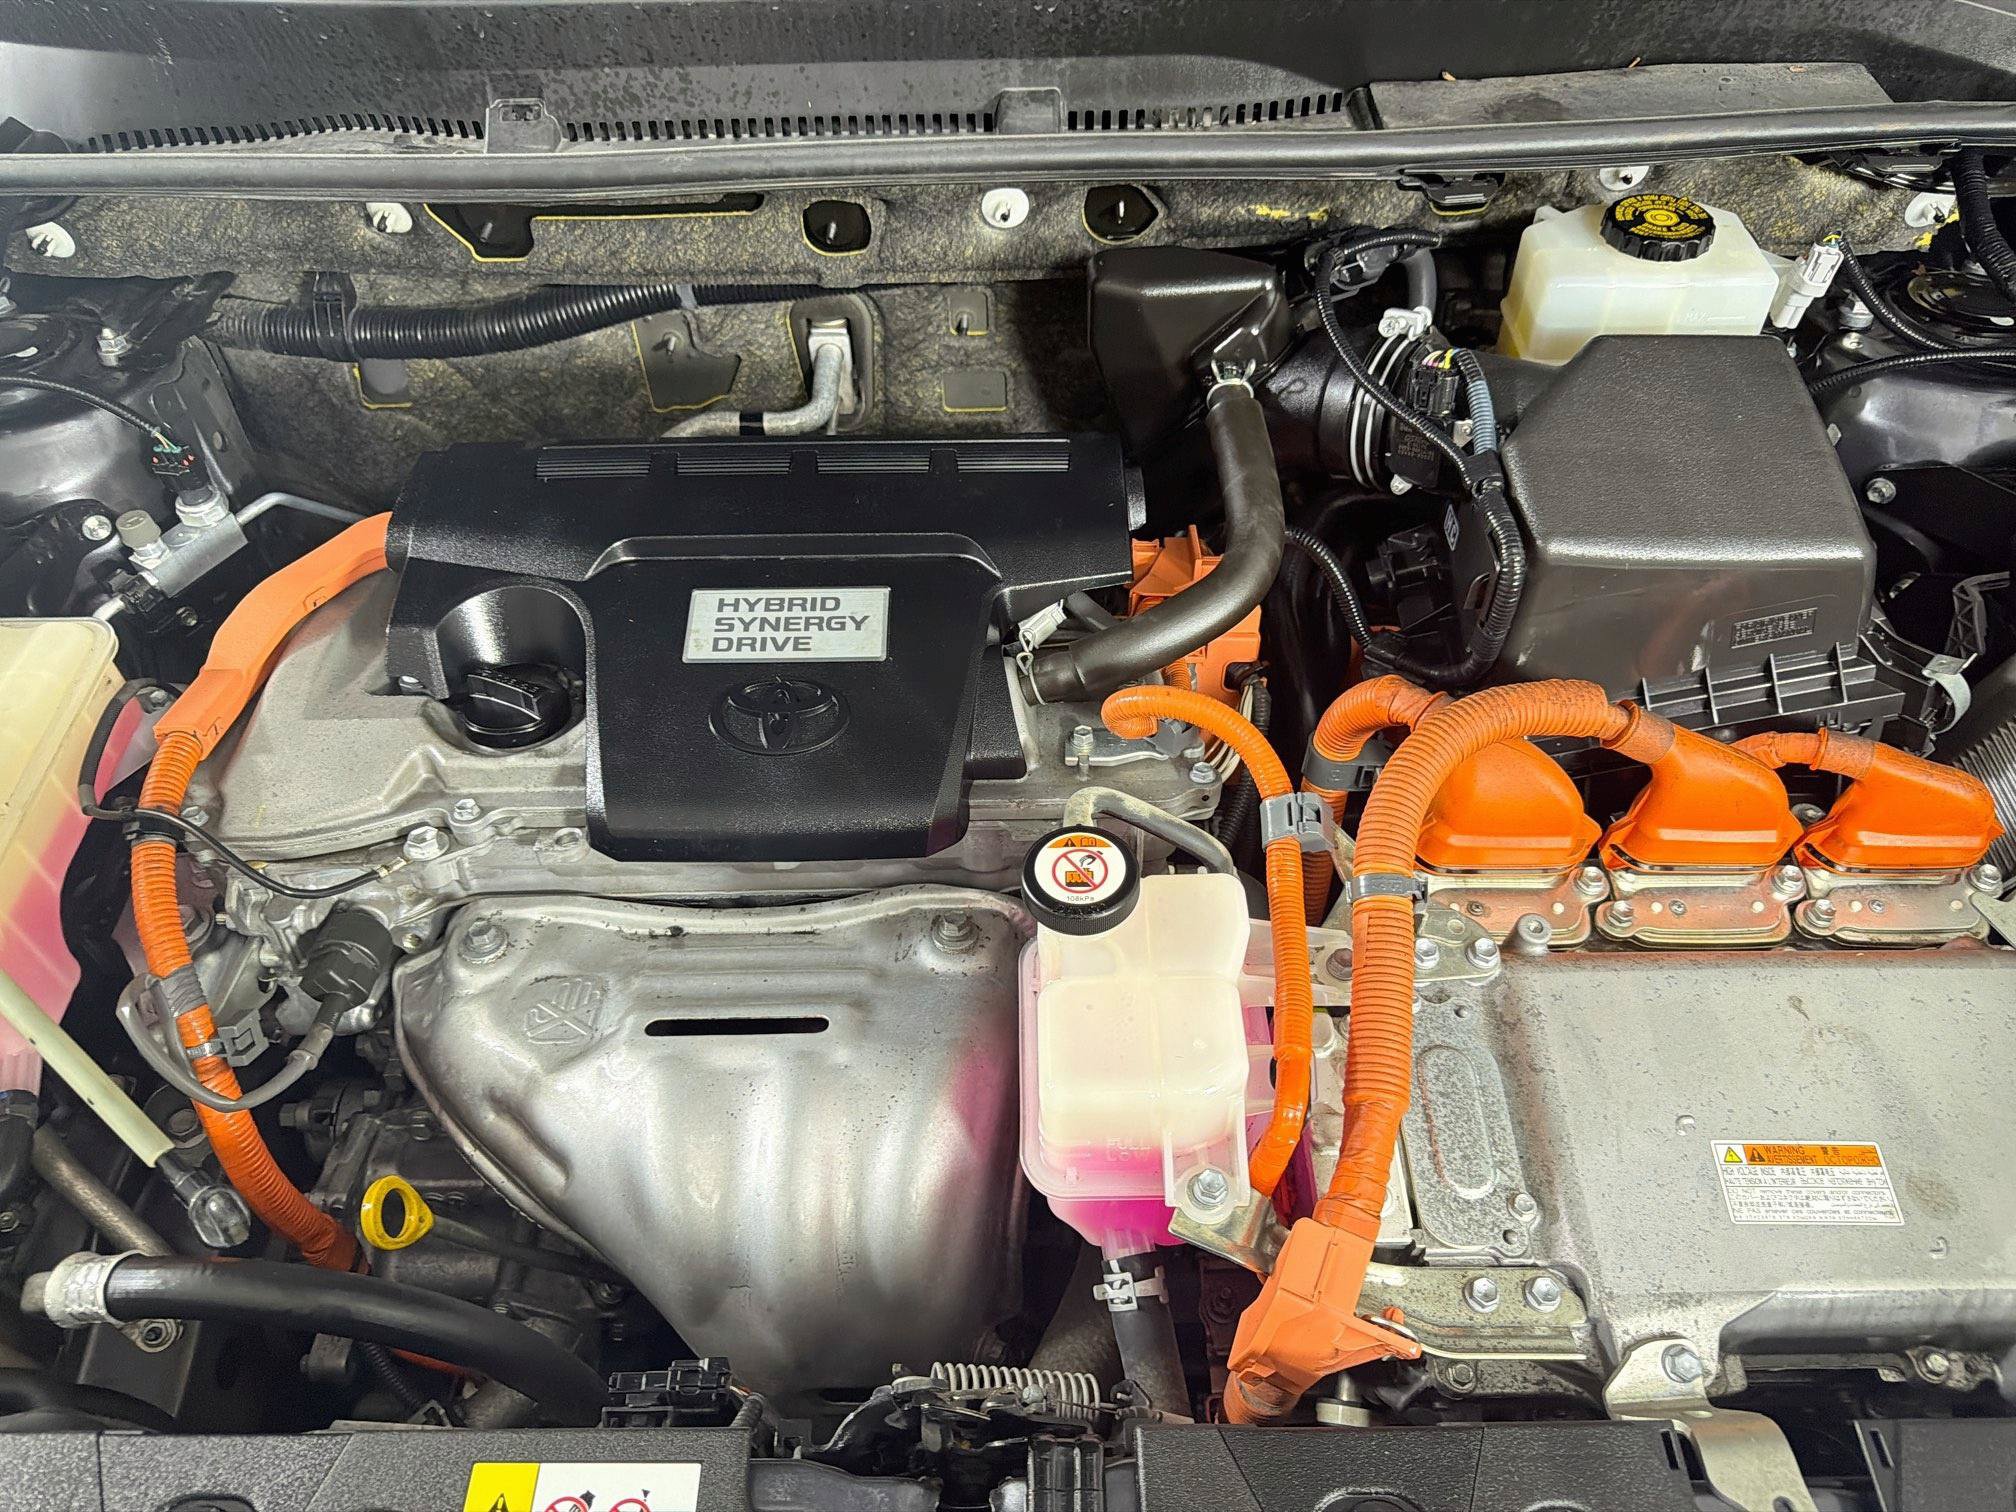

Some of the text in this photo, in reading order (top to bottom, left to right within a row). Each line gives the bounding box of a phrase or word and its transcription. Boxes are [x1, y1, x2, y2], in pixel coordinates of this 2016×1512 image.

[717, 597, 841, 613] HYBRID
[714, 615, 870, 633] SYNERGY
[711, 636, 812, 652] DRIVE
[1763, 1145, 1805, 1155] WARNING
